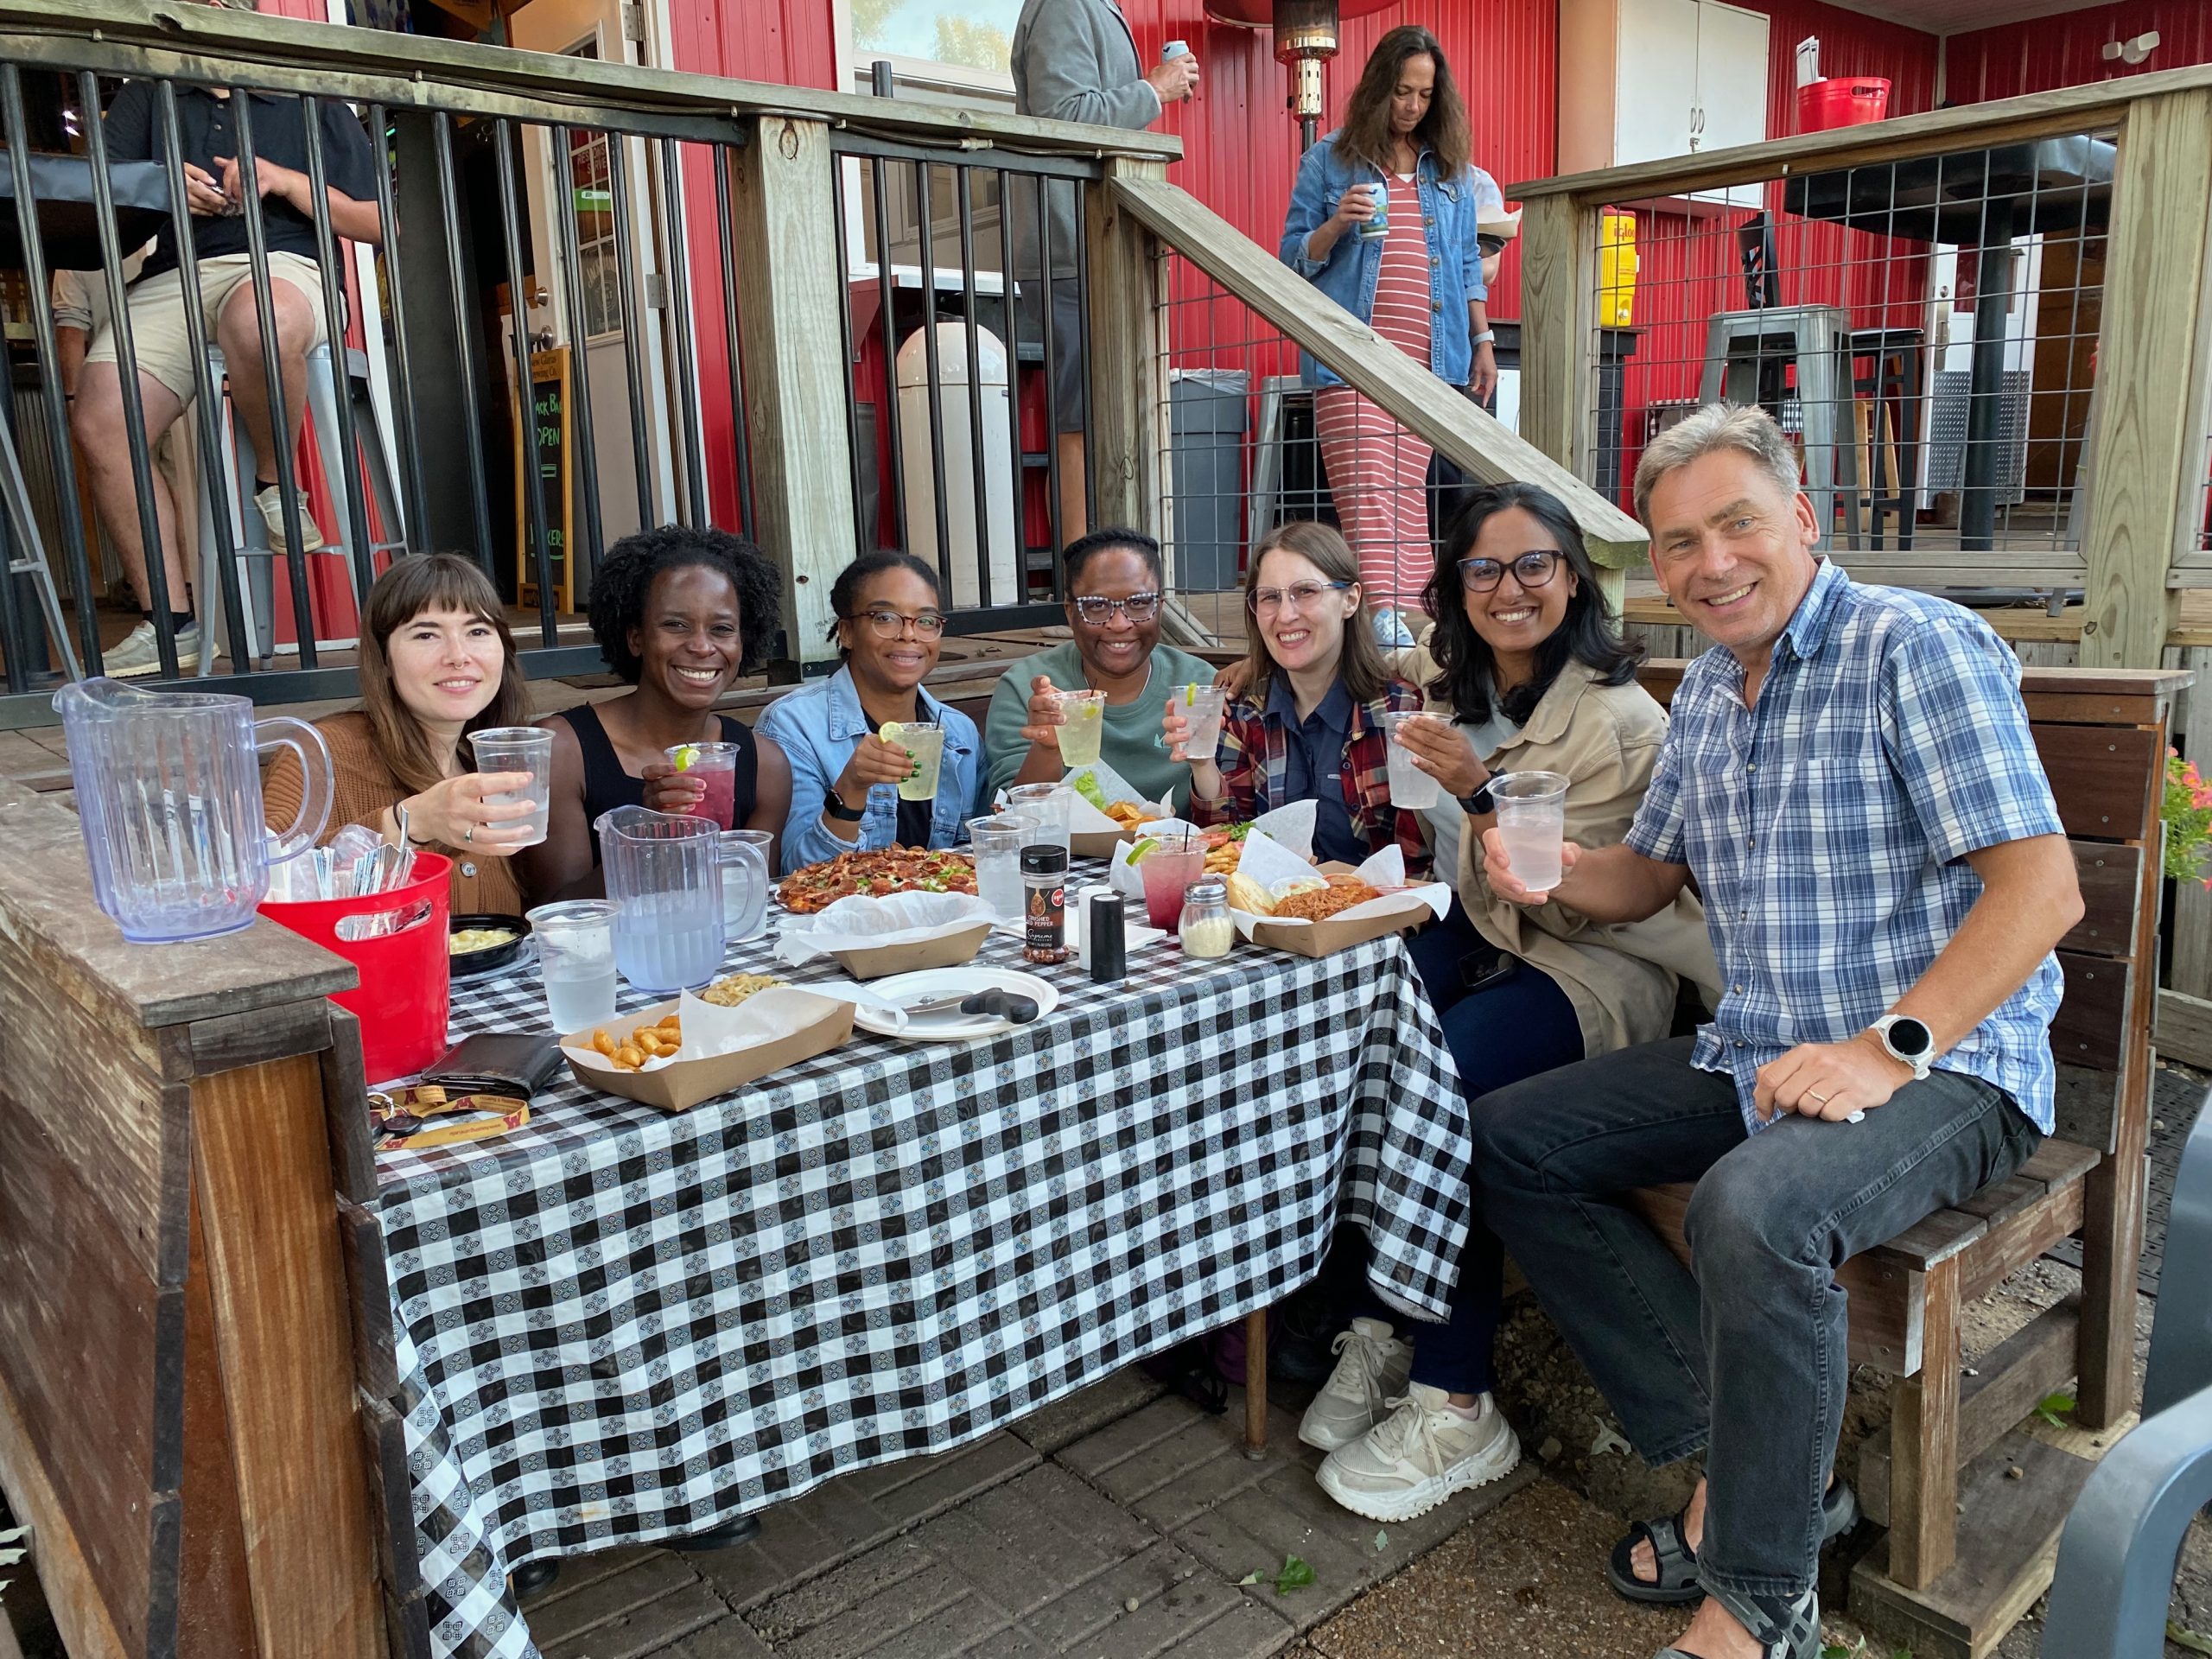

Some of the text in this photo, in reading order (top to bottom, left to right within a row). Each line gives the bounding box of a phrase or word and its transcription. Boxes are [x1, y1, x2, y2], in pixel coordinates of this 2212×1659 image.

[577, 143, 606, 163] RESONS
[587, 156, 607, 175] SRVE
[536, 401, 550, 416] ACK
[1027, 928, 1052, 940] Supreme
